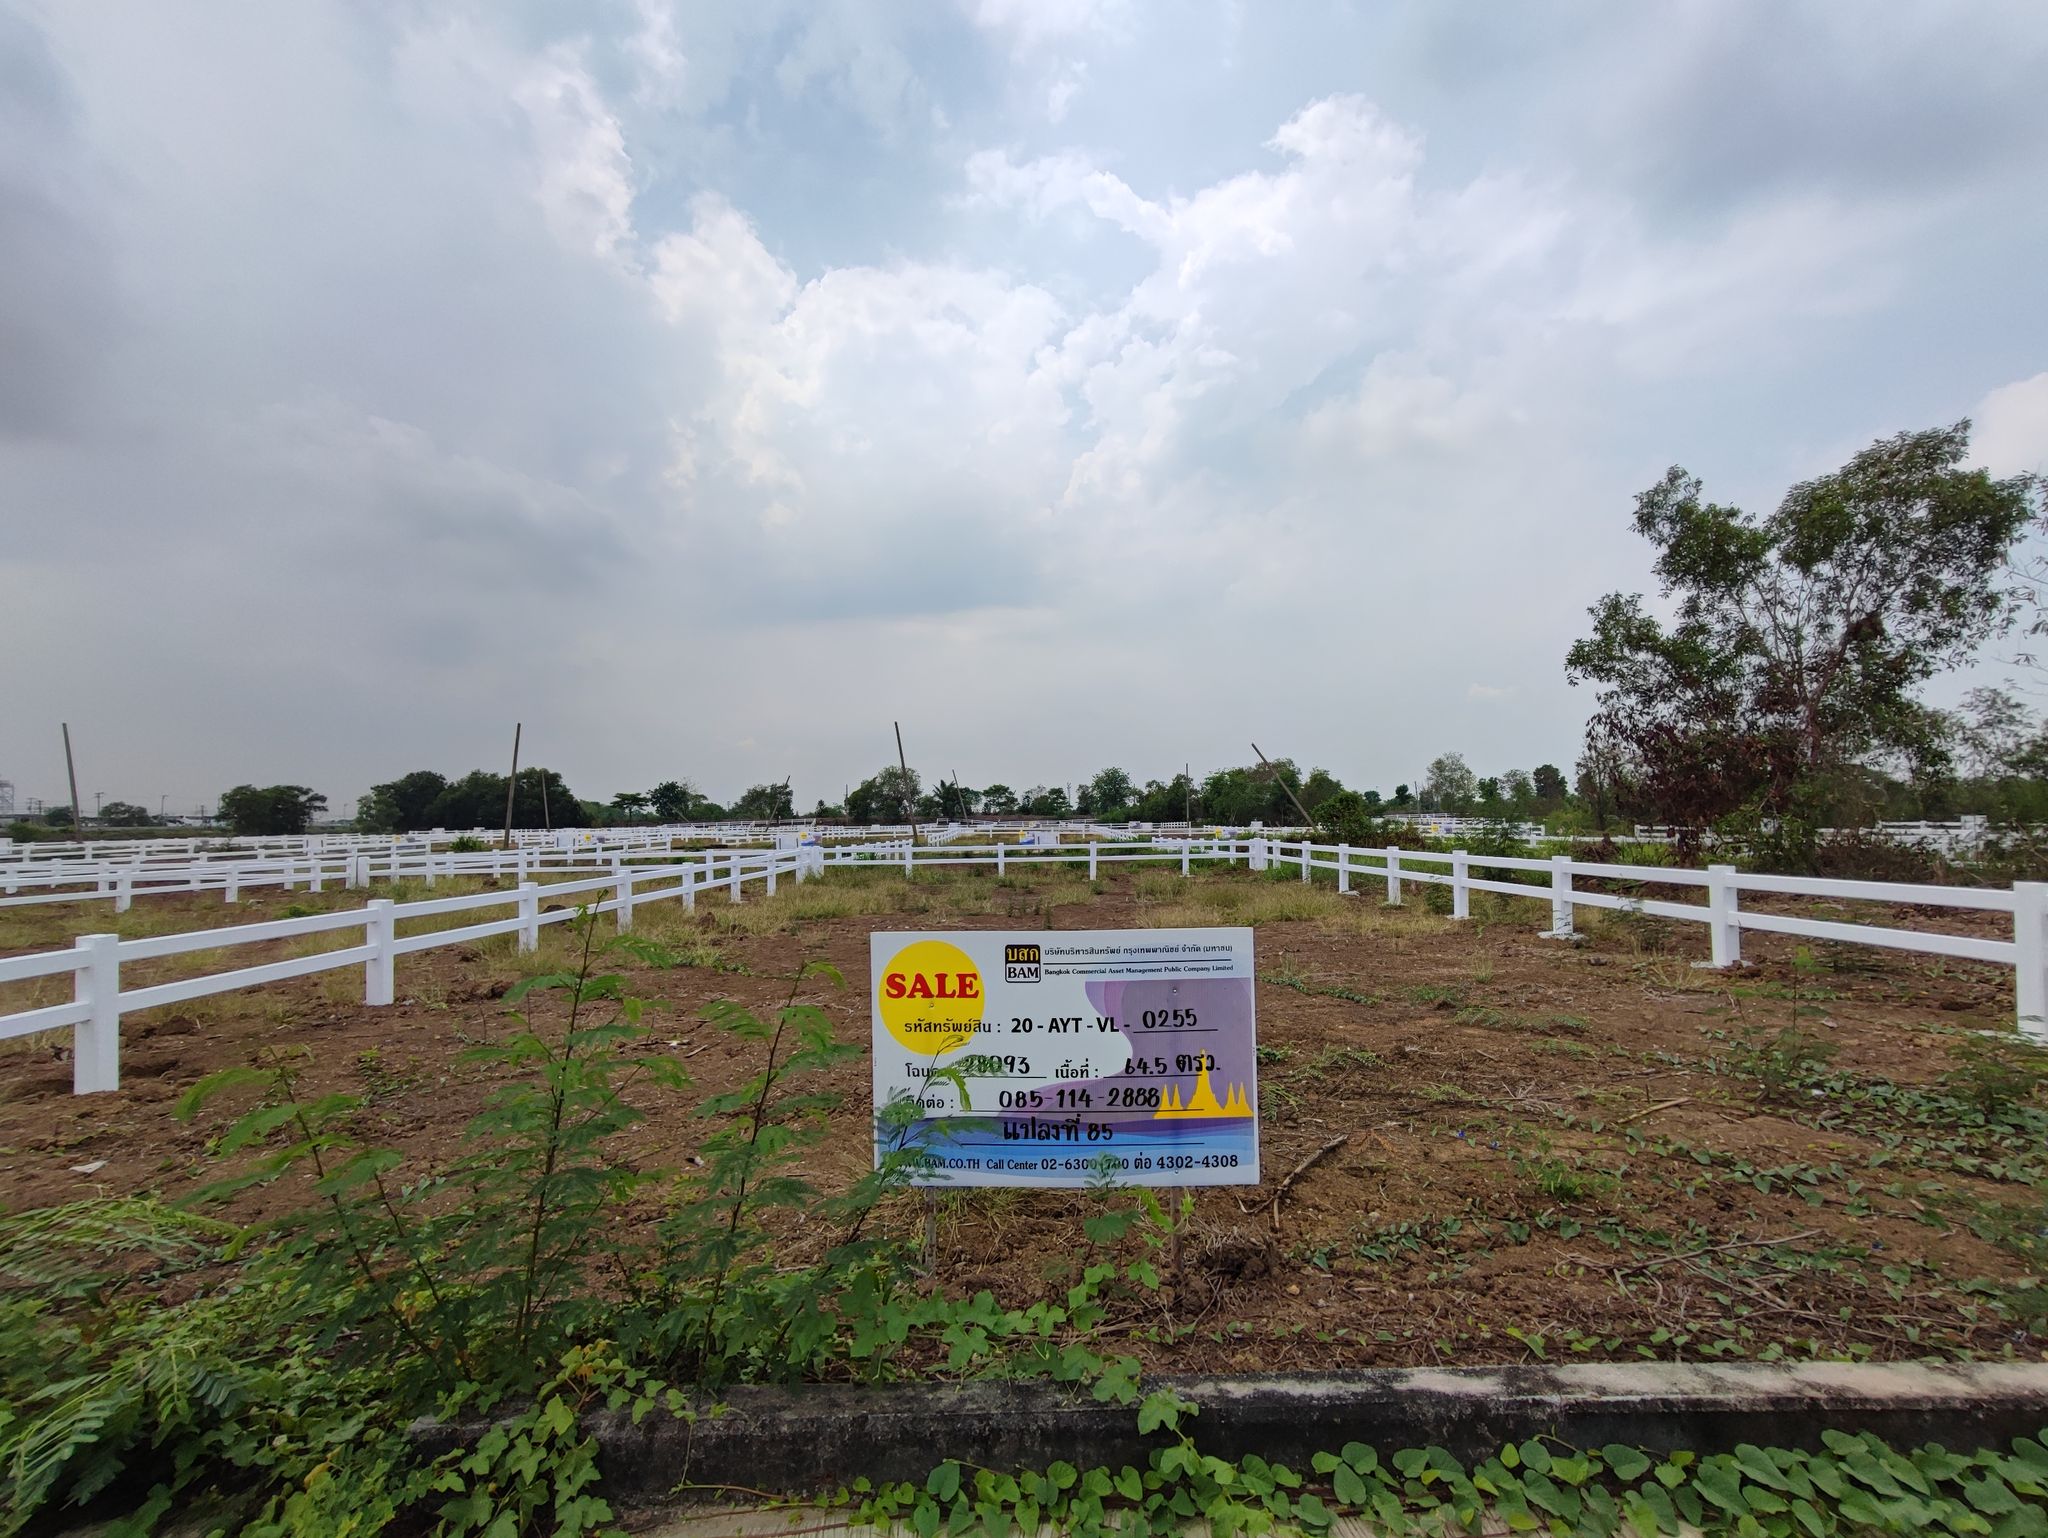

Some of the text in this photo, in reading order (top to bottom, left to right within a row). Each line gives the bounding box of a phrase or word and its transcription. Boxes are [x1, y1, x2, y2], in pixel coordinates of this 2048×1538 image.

[1006, 947, 1039, 962] บสก
[1181, 943, 1201, 953] จำกัด
[1203, 944, 1233, 953] (มหาชน)
[1007, 966, 1039, 979] BAM
[1044, 968, 1070, 976] Bangkok
[1072, 967, 1107, 975] Commercial
[1126, 966, 1163, 975] Management
[1164, 965, 1182, 973] Public
[1183, 965, 1211, 973] Company
[885, 972, 980, 999] SALE
[904, 1017, 992, 1033] รหัสทรัพย์สิน
[1011, 1017, 1033, 1033] 20
[1048, 1017, 1082, 1033] AYT
[1096, 1017, 1120, 1033] VL
[1142, 1007, 1198, 1029] 0255
[1055, 1057, 1090, 1079] เนื้อที่
[1124, 1057, 1168, 1075] 64.5
[1003, 1113, 1113, 1142] แปลงที่ 85
[986, 1158, 1004, 1170] Call
[1007, 1158, 1038, 1170] Center
[1134, 1152, 1152, 1169] ต่อ
[1156, 1155, 1239, 1169] 4302-4308
